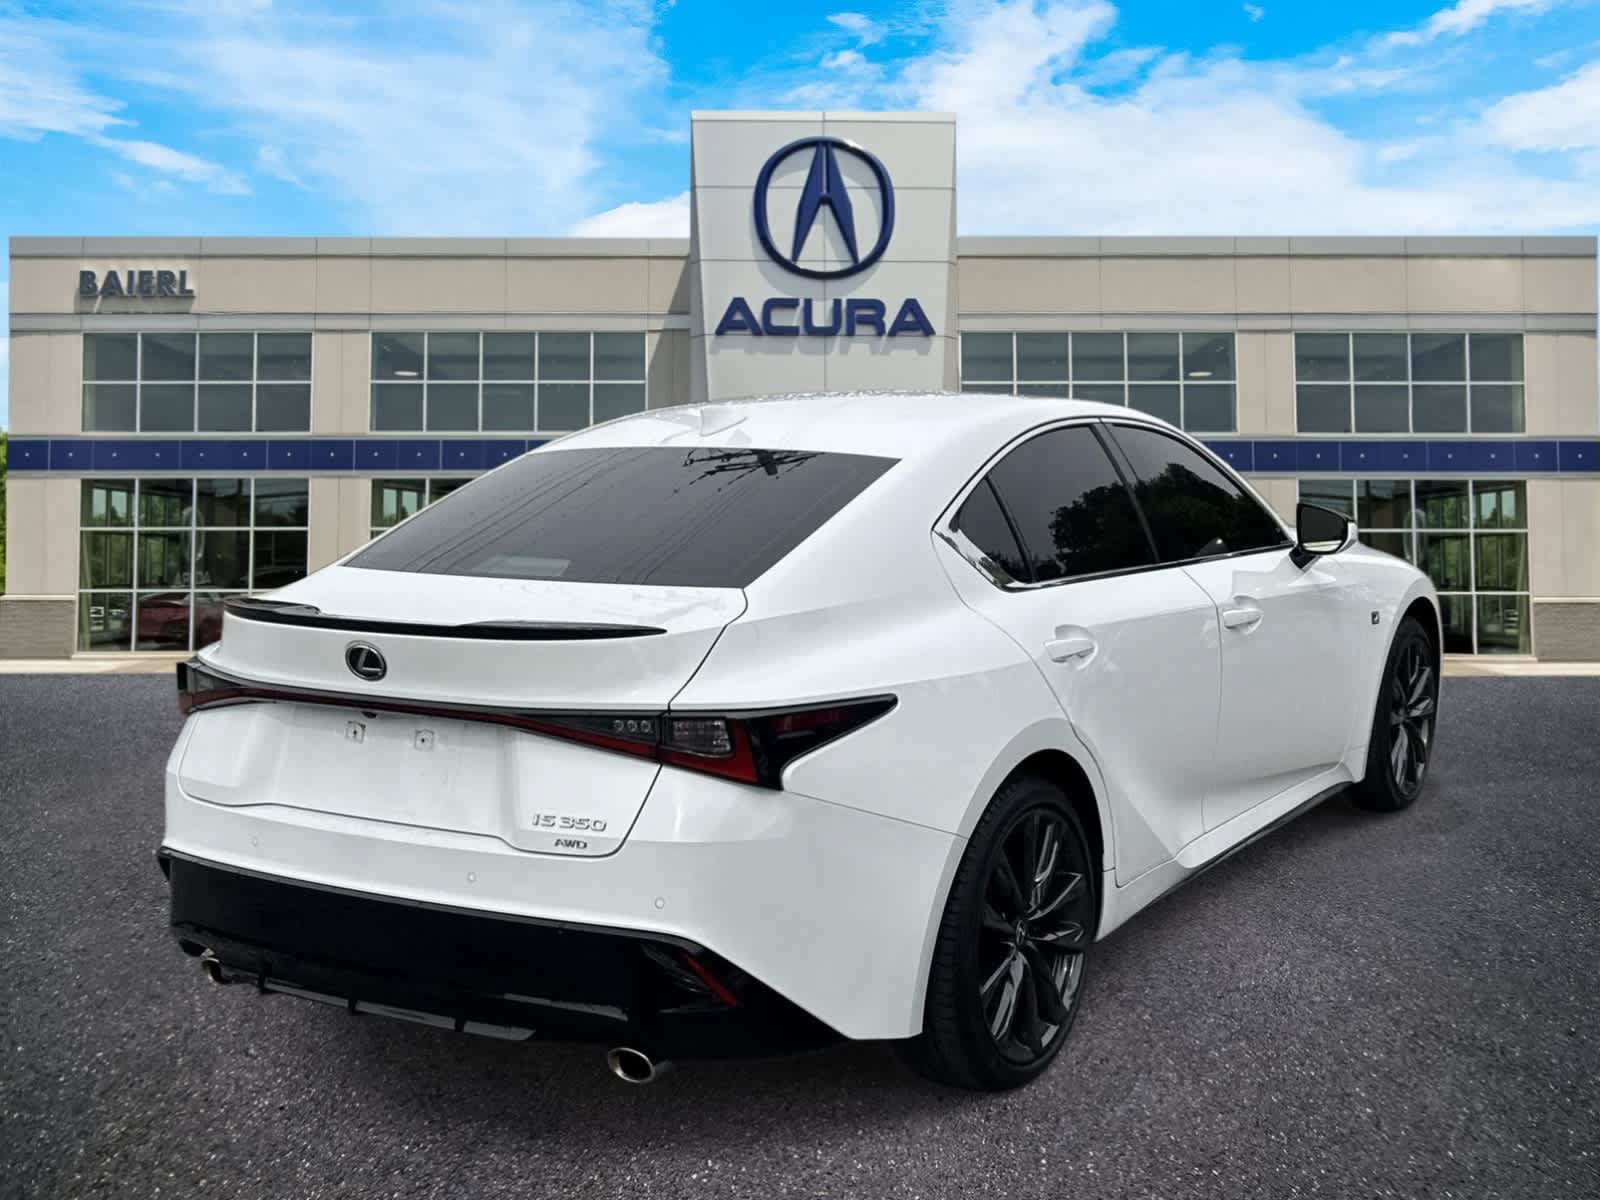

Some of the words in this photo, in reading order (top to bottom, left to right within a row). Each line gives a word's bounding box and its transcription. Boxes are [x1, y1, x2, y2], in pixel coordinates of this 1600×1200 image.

[79, 269, 195, 296] BAIERL
[715, 297, 936, 336] ACURA
[532, 814, 556, 827] IS
[559, 816, 607, 832] 350
[554, 838, 588, 849] AWD
